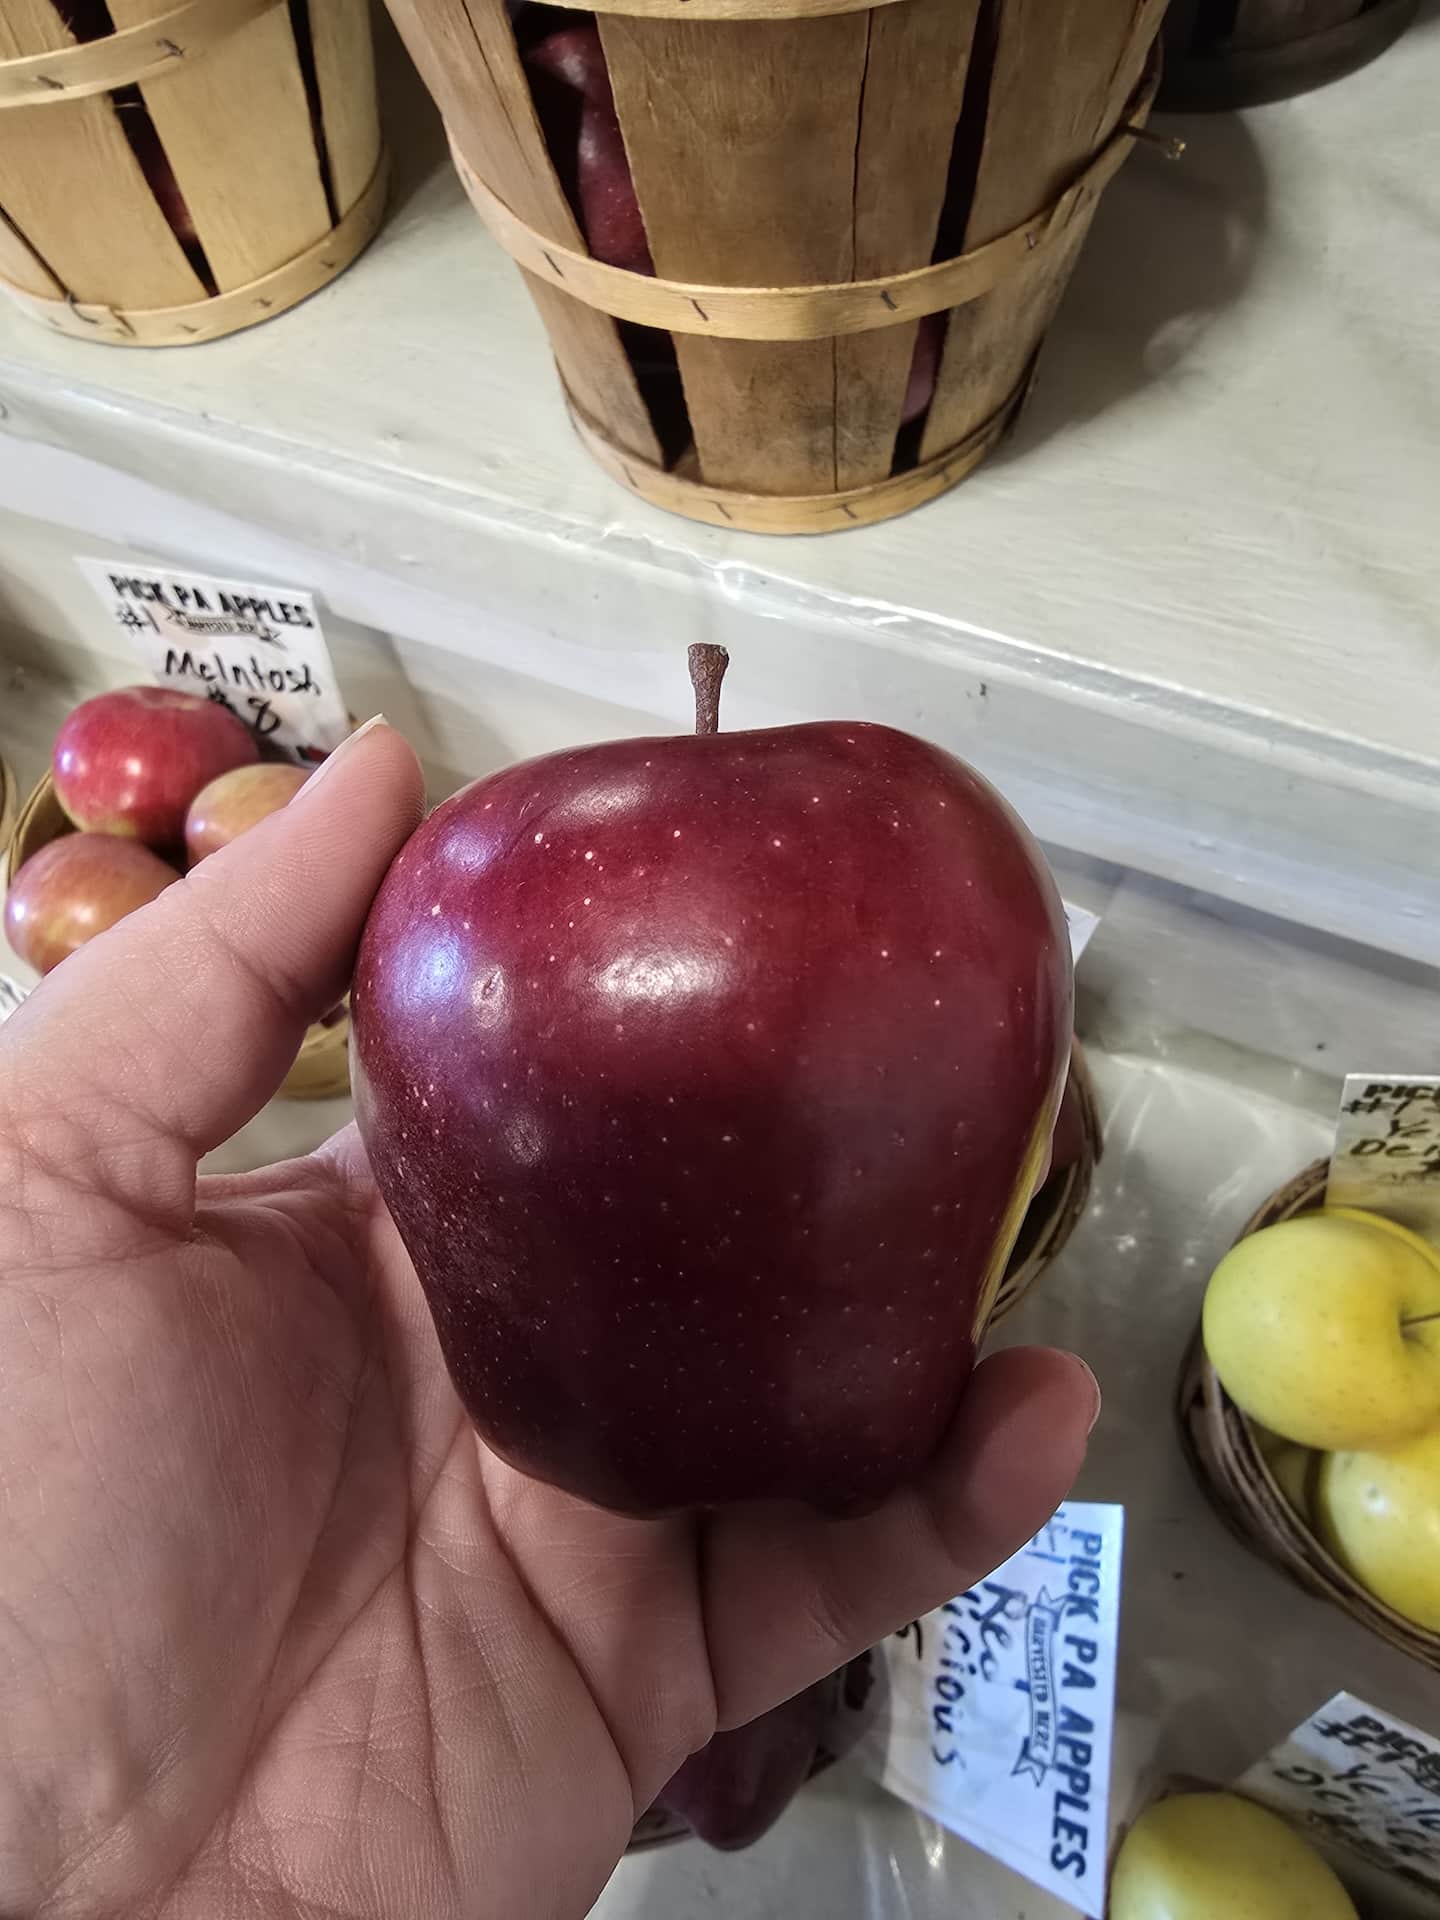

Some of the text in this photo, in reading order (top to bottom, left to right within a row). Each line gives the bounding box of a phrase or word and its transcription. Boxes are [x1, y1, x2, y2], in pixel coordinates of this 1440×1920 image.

[109, 575, 170, 605] PICK
[173, 584, 212, 612] PA
[218, 591, 315, 629] APPLES
[164, 649, 322, 697] McIntosh
[1050, 1529, 1102, 1880] PICK PA APPLES
